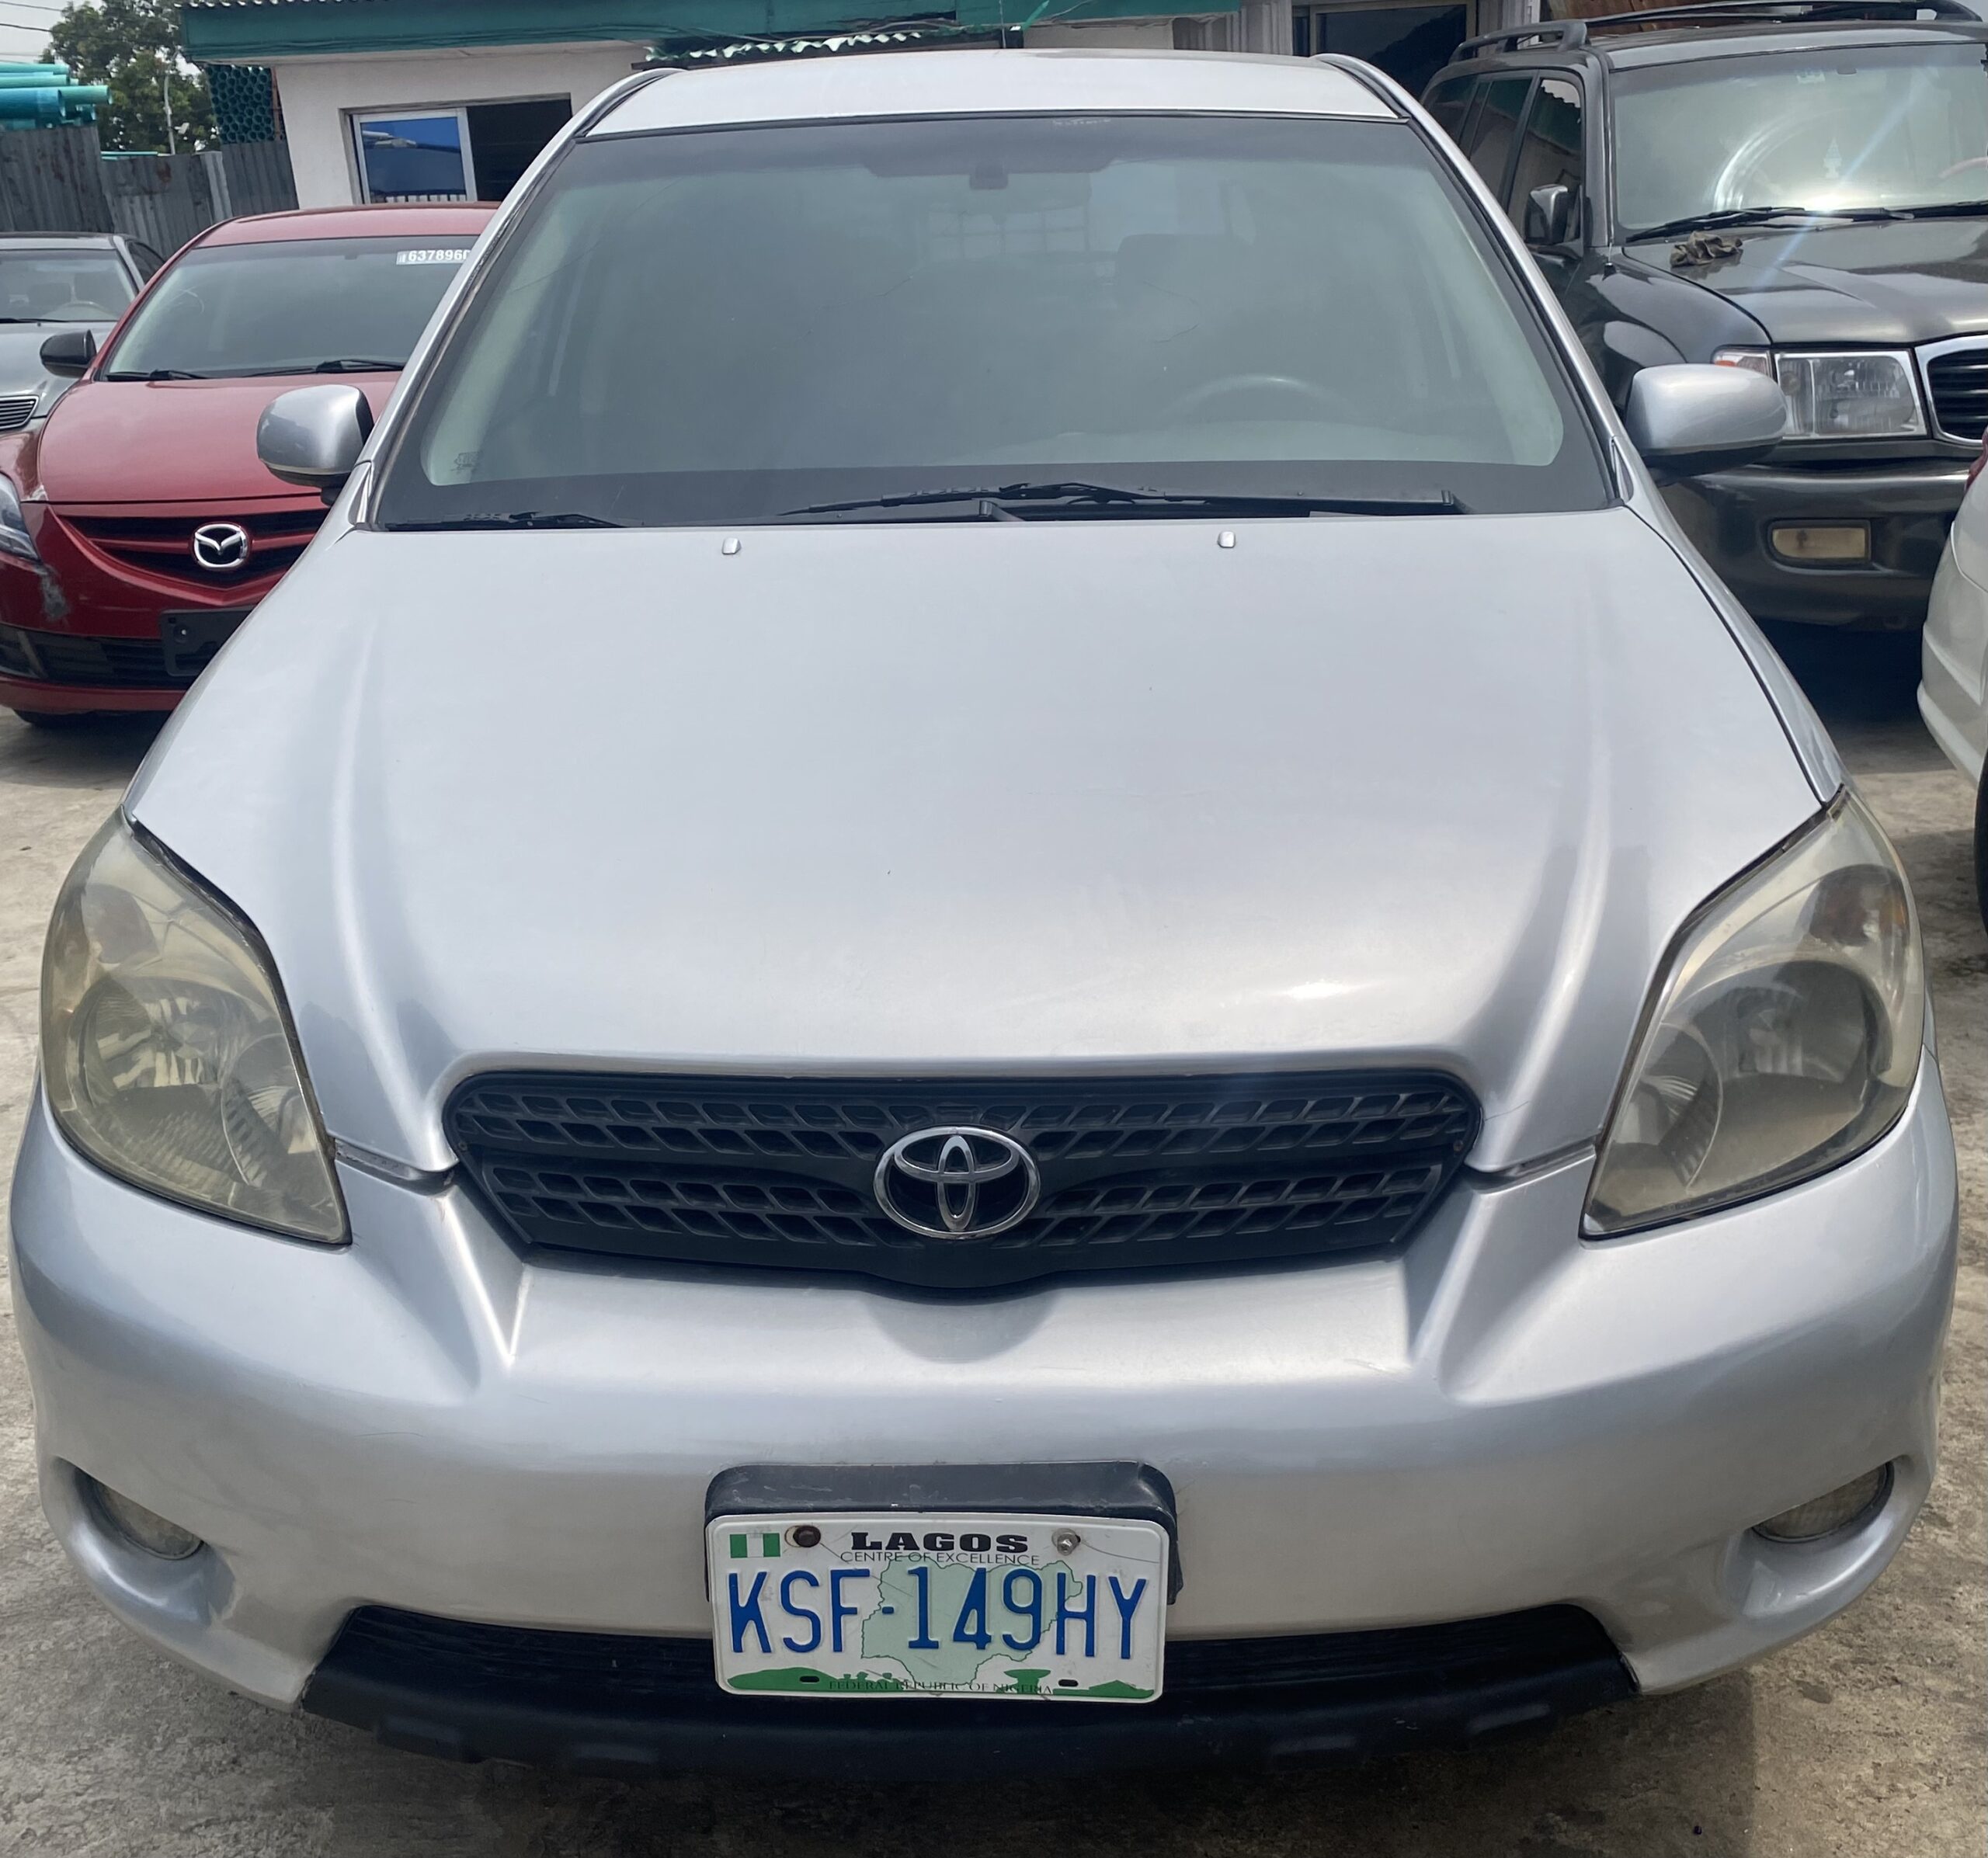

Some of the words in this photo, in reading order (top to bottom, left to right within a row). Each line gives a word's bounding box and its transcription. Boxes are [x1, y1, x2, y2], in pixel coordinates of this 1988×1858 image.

[851, 1532, 1028, 1553] LAGOS
[839, 1551, 905, 1563] CENTRE
[908, 1551, 930, 1563] OF
[937, 1552, 1041, 1565] EXCELLENCE
[829, 1681, 890, 1690] FEDERAL
[894, 1681, 966, 1691] REPUBLIC
[969, 1683, 988, 1692] OF
[992, 1683, 1053, 1694] NIGERIA
